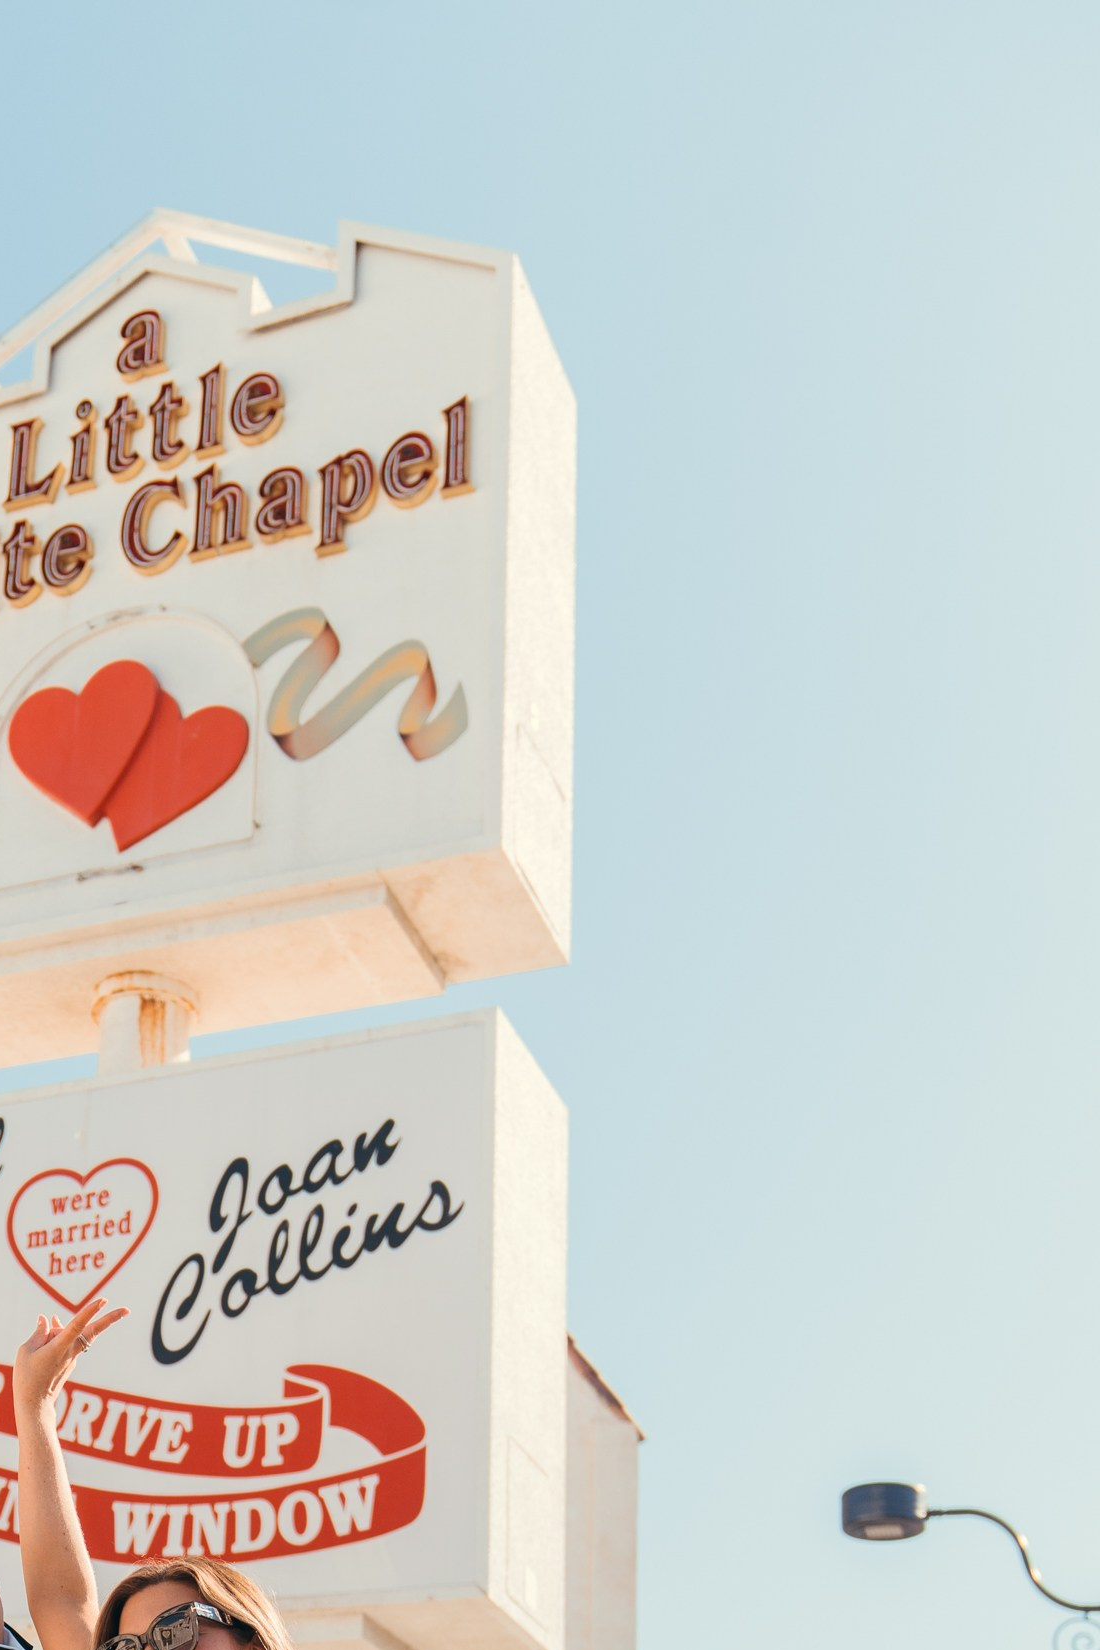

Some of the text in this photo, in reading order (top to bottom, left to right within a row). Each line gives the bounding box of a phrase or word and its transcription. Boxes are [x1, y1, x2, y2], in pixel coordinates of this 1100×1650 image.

[116, 308, 168, 382] a
[2, 363, 285, 511] Little
[119, 395, 477, 576] Chapel
[27, 1210, 132, 1249] married
[51, 1189, 110, 1215] were
[208, 1118, 402, 1274] Joan
[49, 1250, 105, 1276] here
[150, 1179, 465, 1365] Collins
[222, 1411, 301, 1469] UP
[111, 1474, 380, 1557] WINDOW
